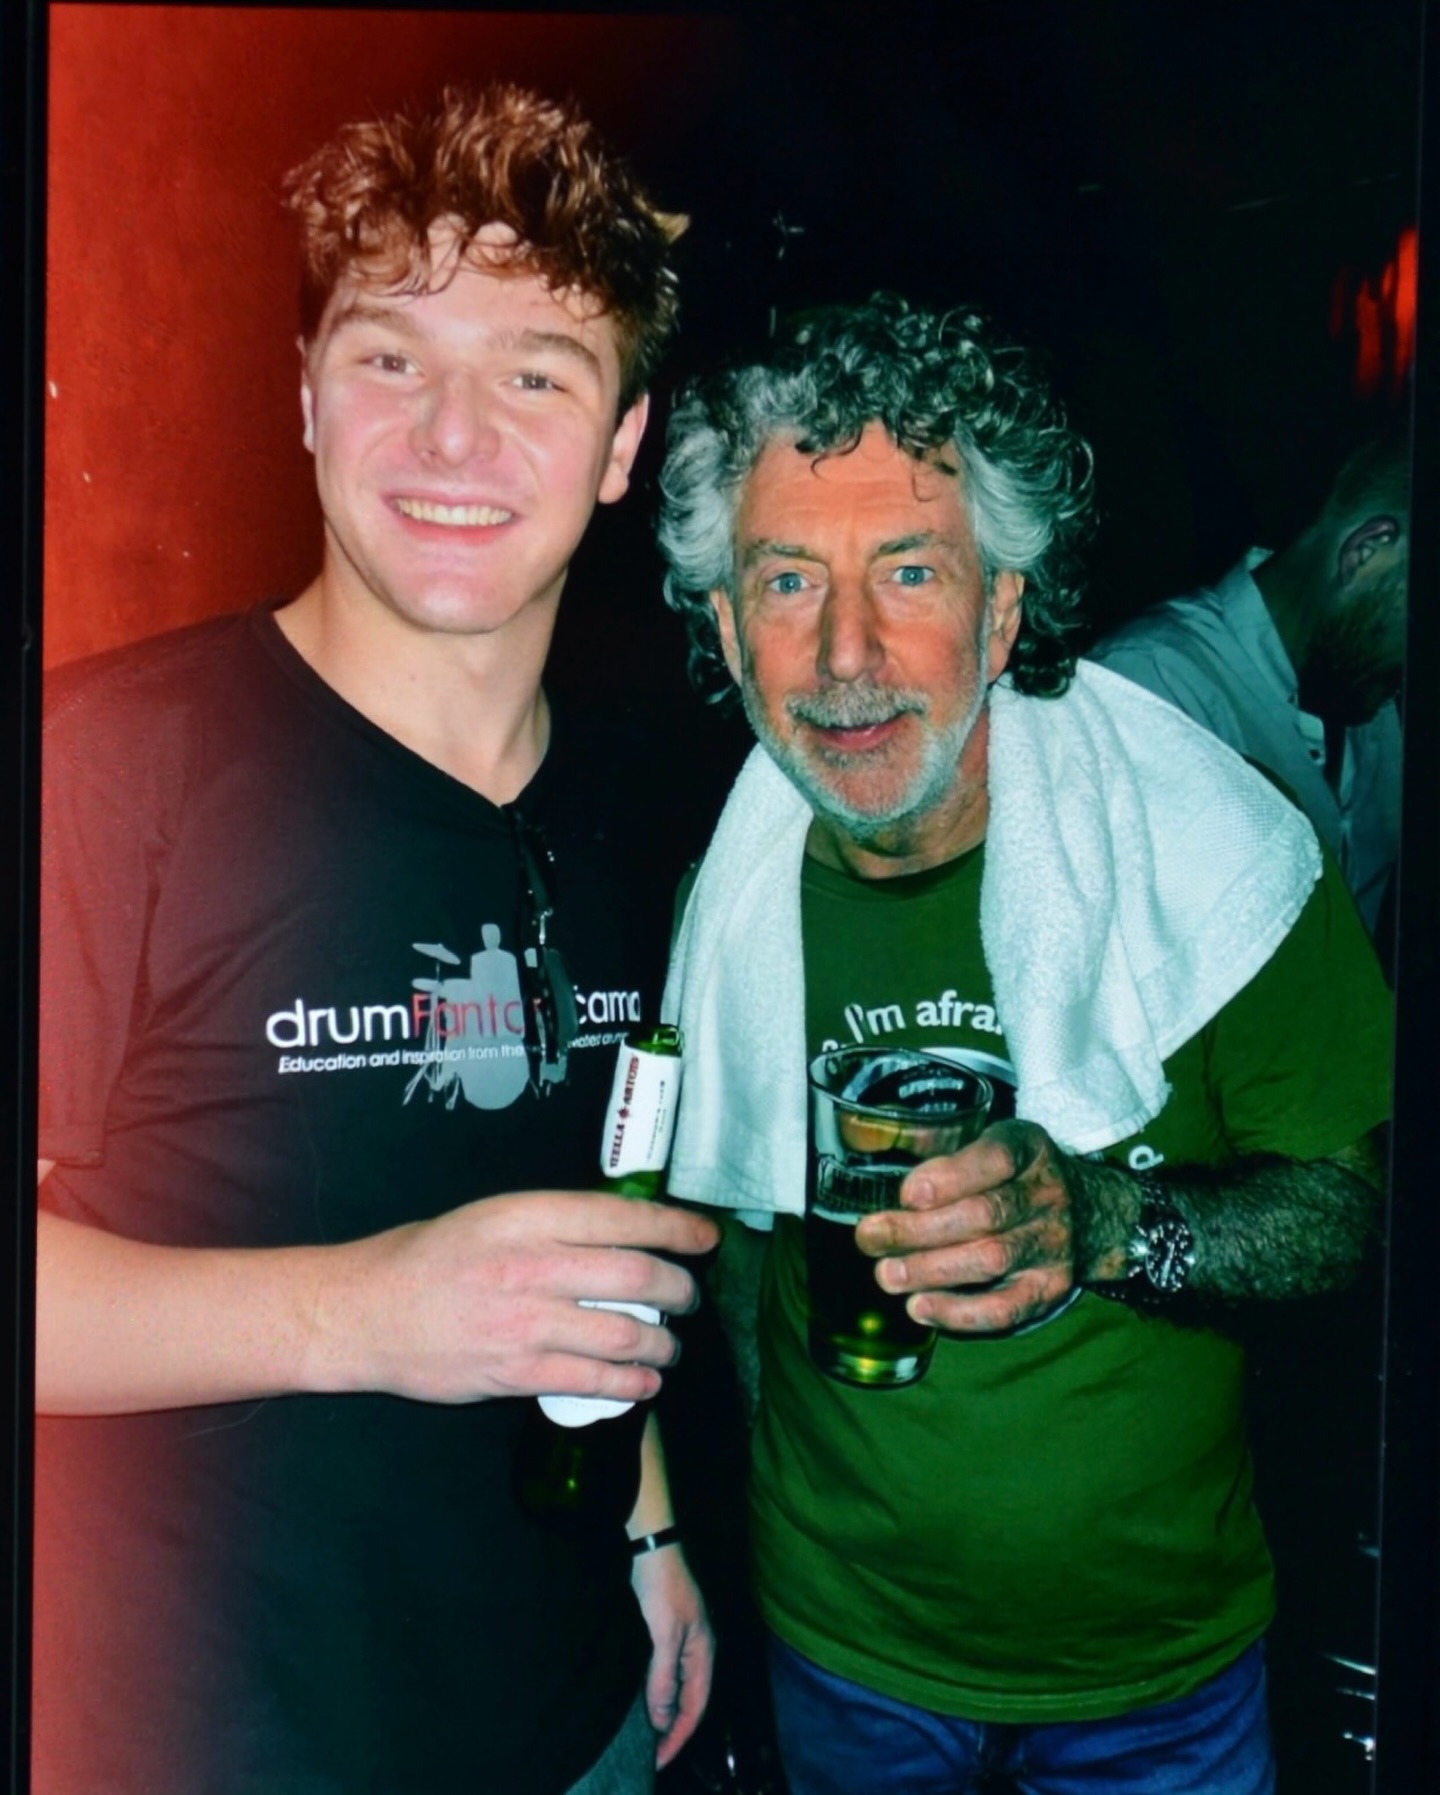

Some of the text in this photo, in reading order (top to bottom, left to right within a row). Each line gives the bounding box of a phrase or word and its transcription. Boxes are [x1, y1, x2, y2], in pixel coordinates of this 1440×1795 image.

[844, 989, 1003, 1043] I'm afra
[278, 1053, 366, 1075] Education
[369, 1049, 401, 1068] and
[468, 1045, 499, 1061] from
[501, 1043, 526, 1058] the
